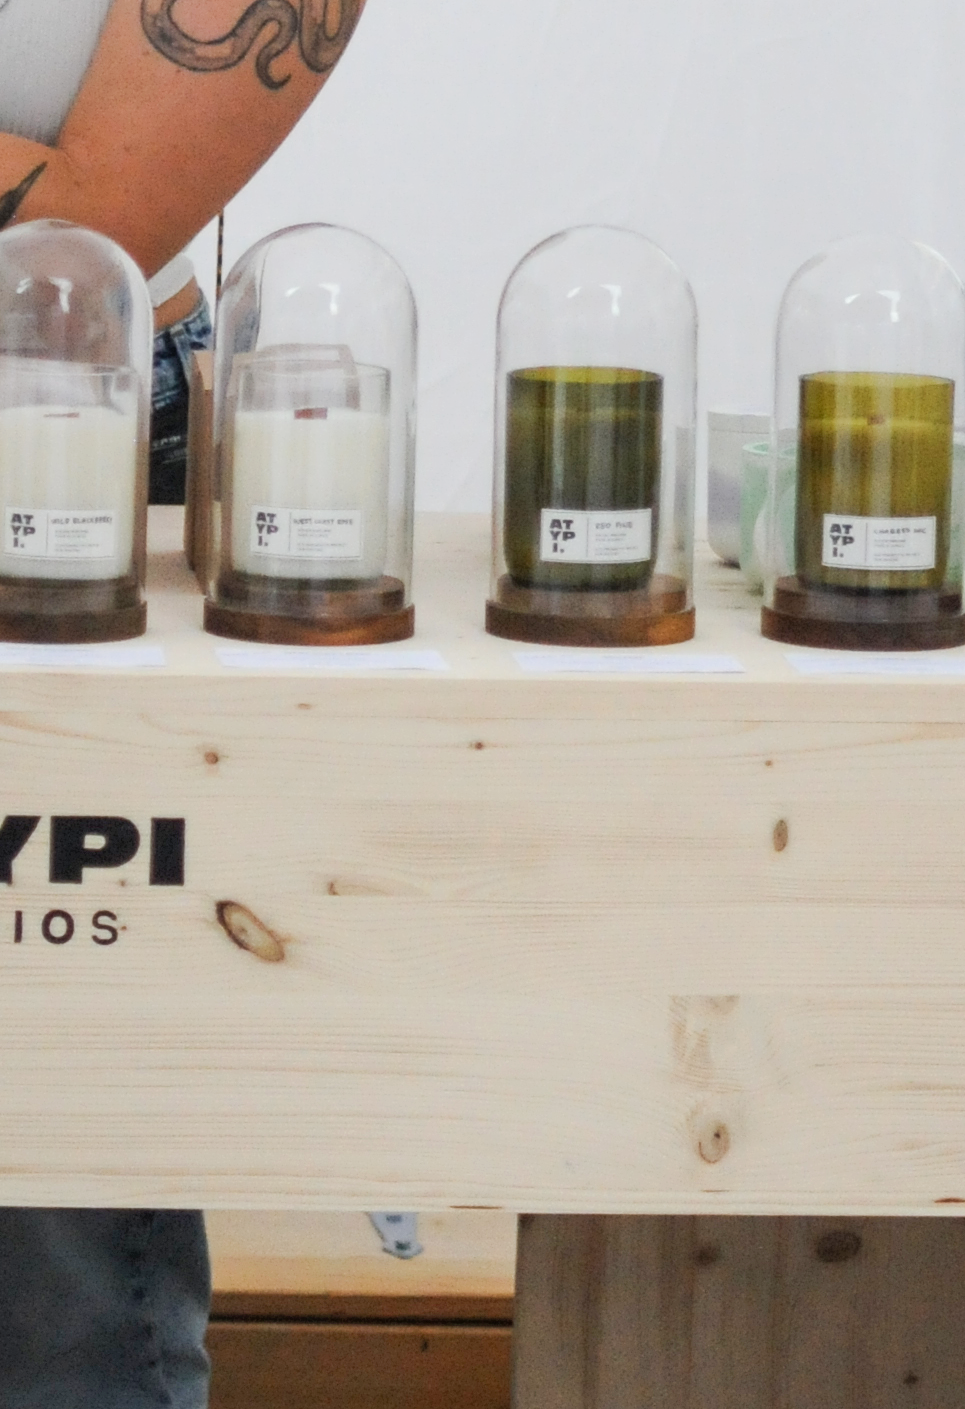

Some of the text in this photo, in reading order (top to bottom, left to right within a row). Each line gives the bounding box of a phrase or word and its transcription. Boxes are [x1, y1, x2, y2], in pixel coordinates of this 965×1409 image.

[11, 513, 34, 525] AT
[256, 511, 277, 523] AT
[256, 523, 279, 535] YP
[550, 518, 574, 530] AT
[829, 523, 854, 535] AT
[11, 525, 36, 536] YP
[550, 530, 576, 541] YP
[829, 534, 855, 546] YP
